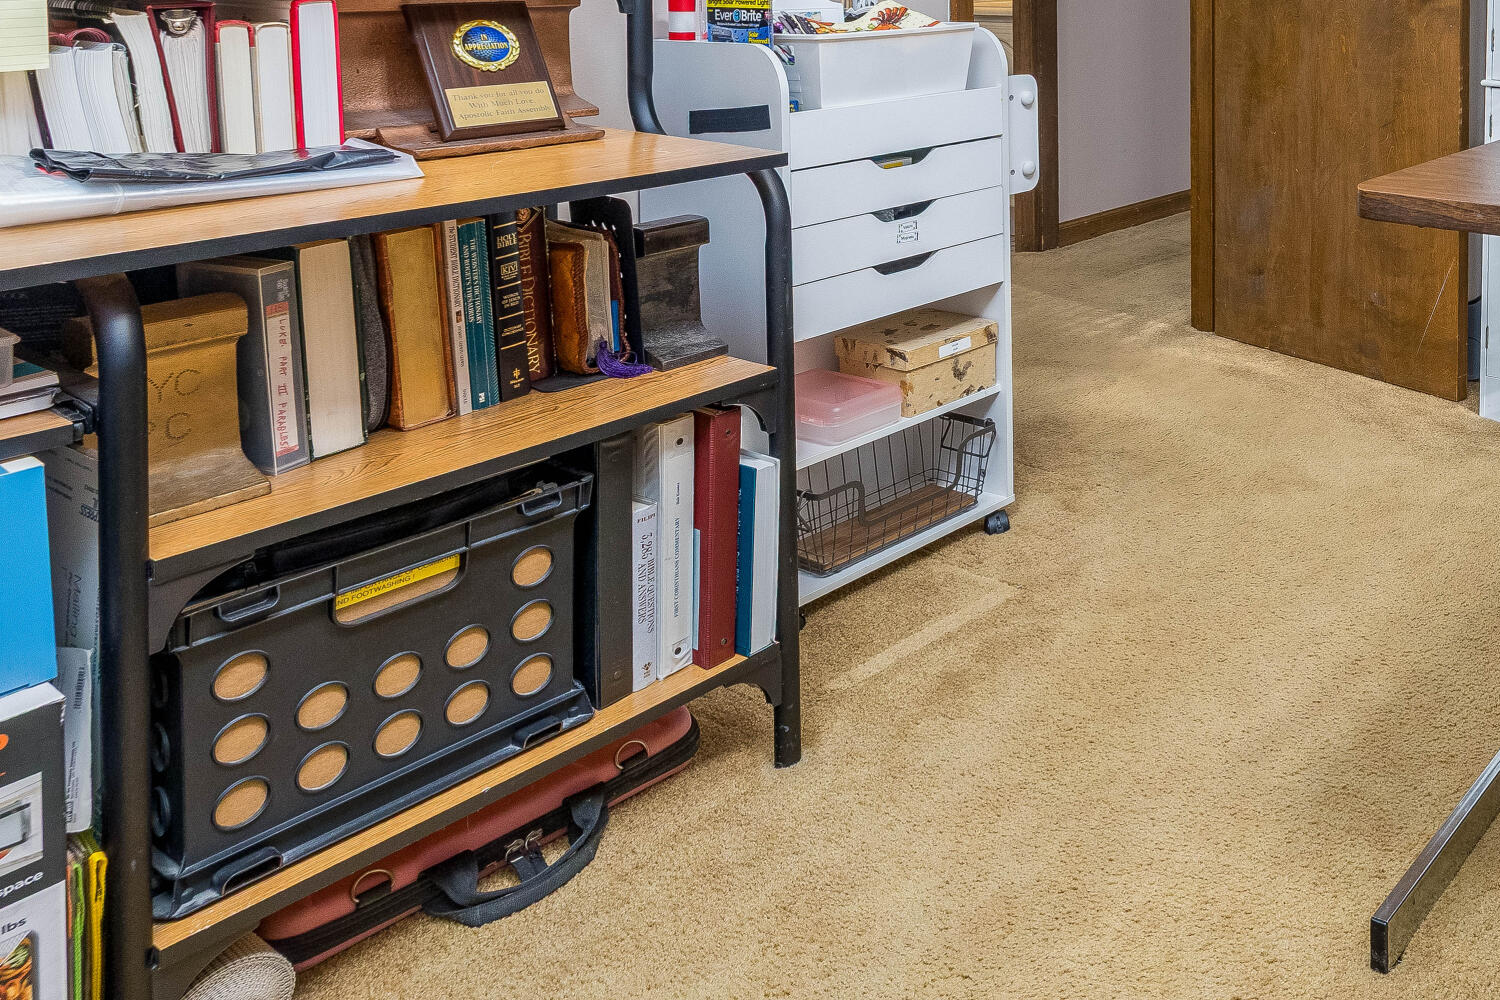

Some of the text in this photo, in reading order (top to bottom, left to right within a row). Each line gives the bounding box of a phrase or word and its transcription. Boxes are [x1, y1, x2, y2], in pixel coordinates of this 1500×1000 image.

[464, 42, 509, 51] APPRECIATION
[453, 94, 478, 102] Thank
[520, 89, 533, 97] you
[469, 101, 489, 109] With
[459, 111, 494, 121] Apostolic
[518, 105, 552, 114] Assembly
[449, 234, 457, 259] STUDENT
[496, 232, 517, 242] HOLY
[496, 239, 518, 249] BIBLE
[464, 259, 472, 285] ROGET'S
[471, 252, 479, 284] WEBSTER'S
[452, 276, 461, 308] DICTIONARY
[474, 285, 482, 324] DICTIONARY
[466, 287, 475, 323] THESAURUS
[522, 276, 541, 374] DICTIONARY
[279, 356, 288, 376] PART
[337, 596, 349, 605] ND
[351, 576, 411, 600] FOOTWASHING
[637, 563, 647, 625] AND ANSWERS
[646, 558, 656, 634] BIBLE QUESTIONS
[1, 918, 26, 934] lbs
